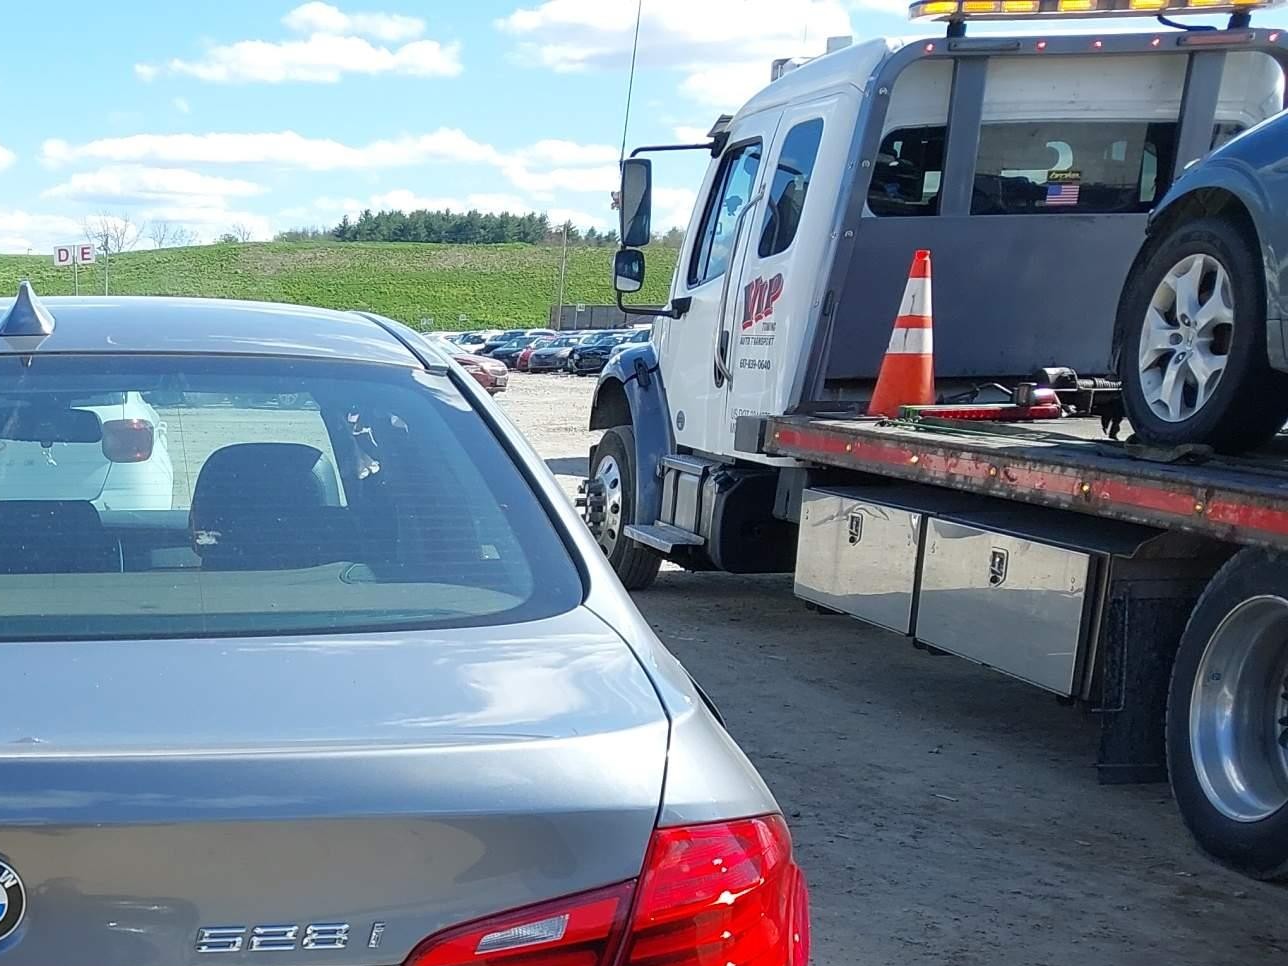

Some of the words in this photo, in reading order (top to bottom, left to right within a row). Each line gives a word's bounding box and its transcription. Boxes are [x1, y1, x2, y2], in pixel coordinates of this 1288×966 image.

[58, 248, 69, 262] D
[81, 246, 91, 261] E
[742, 273, 784, 331] VIP
